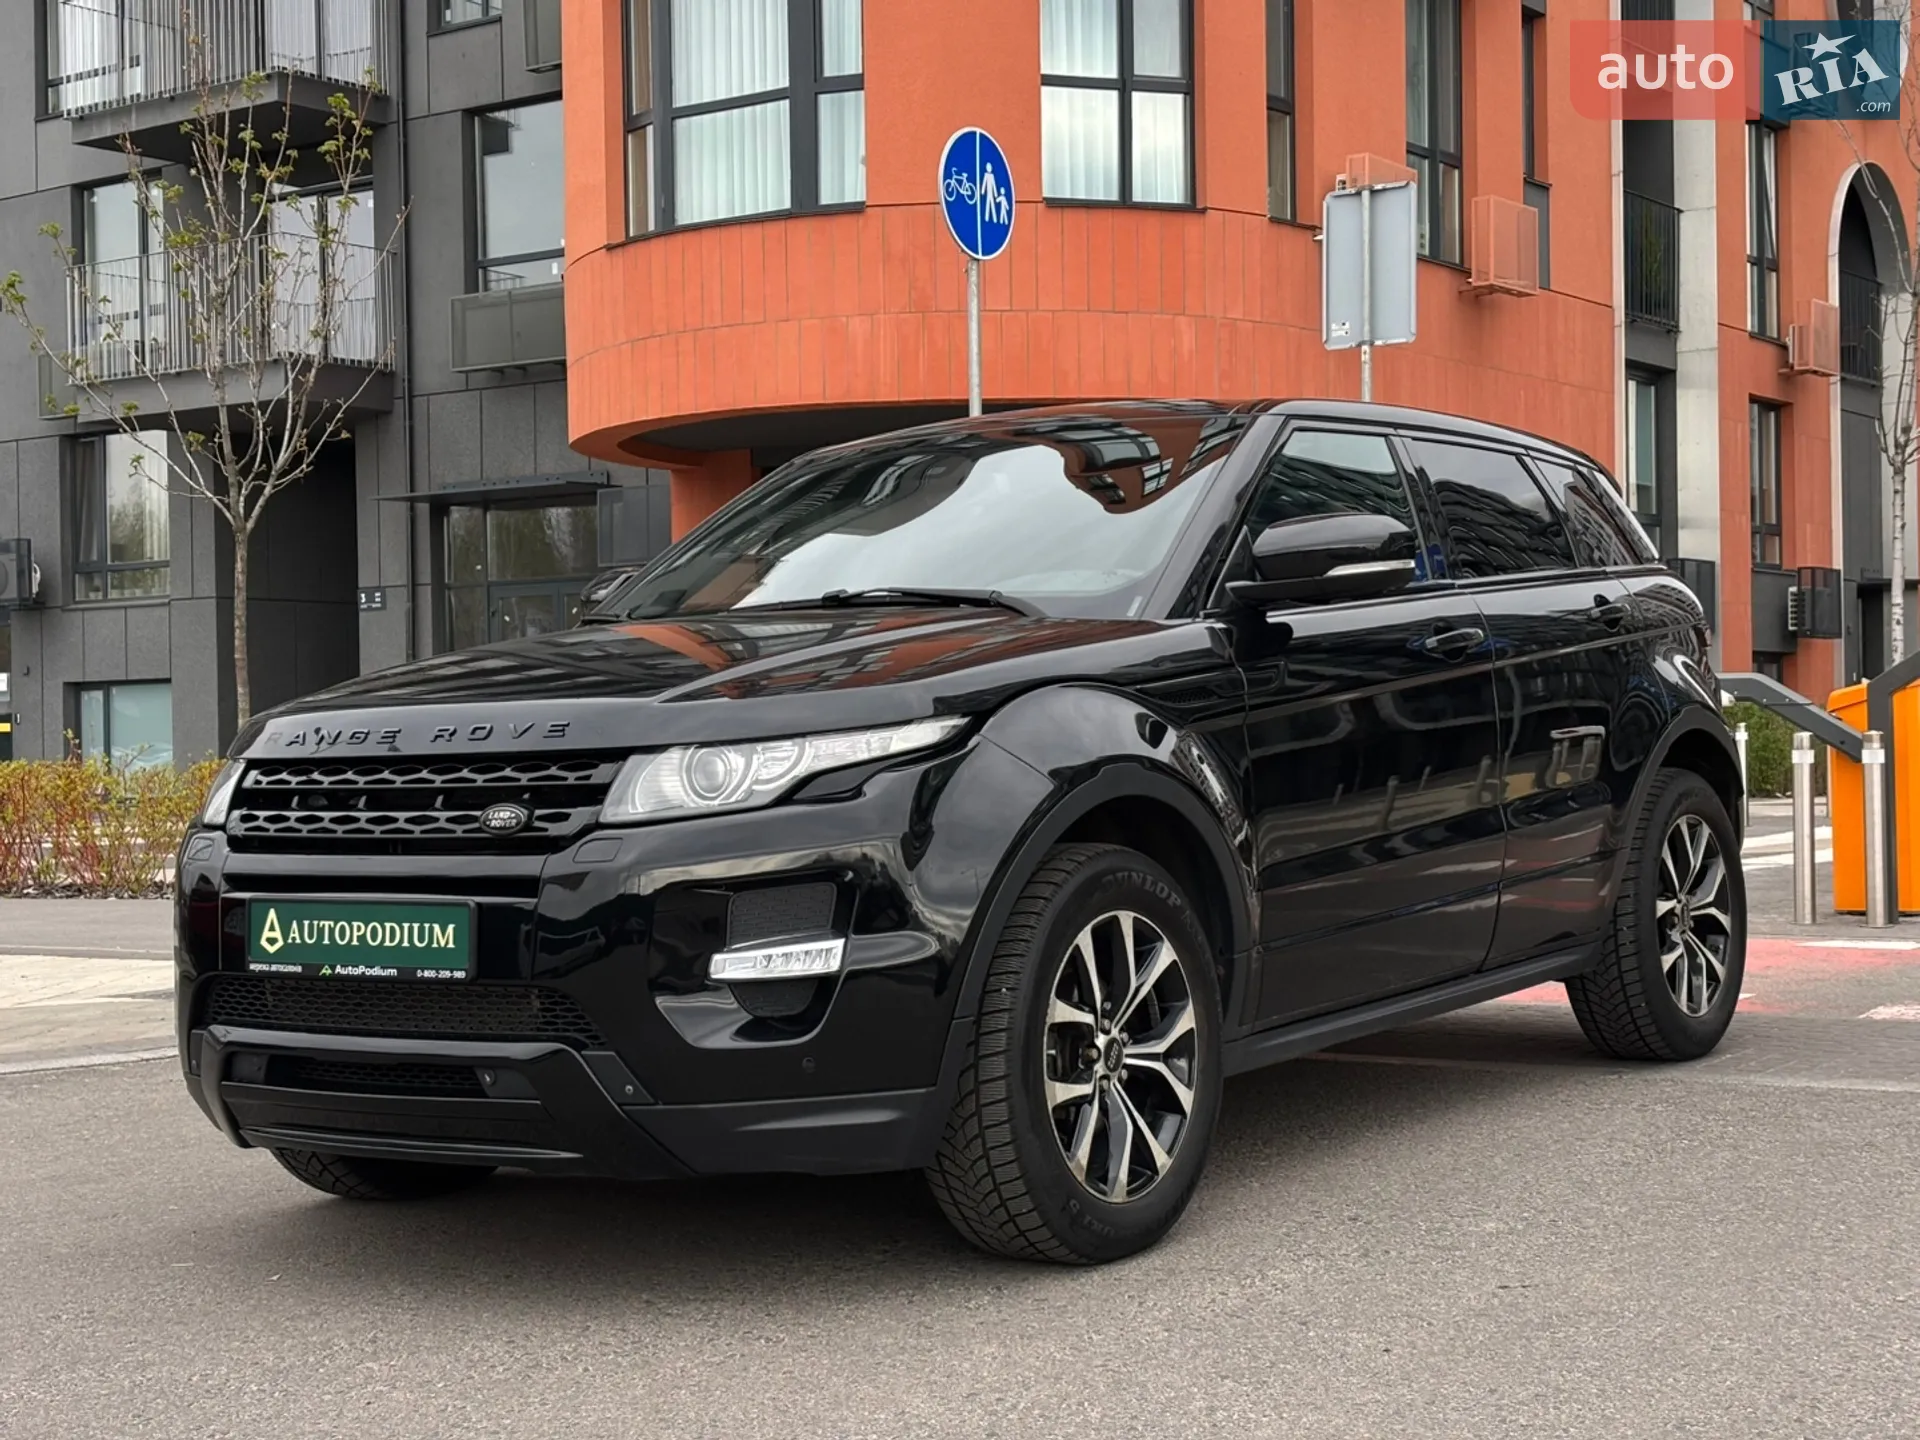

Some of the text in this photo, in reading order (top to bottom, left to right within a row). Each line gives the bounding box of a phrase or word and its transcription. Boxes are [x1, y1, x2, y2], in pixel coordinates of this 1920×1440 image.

[488, 811, 511, 819] LAND
[490, 819, 517, 828] ROVER
[1100, 870, 1182, 908] DUNLOP
[287, 920, 456, 948] AUTOPODIUM
[335, 965, 397, 977] AutoPodium
